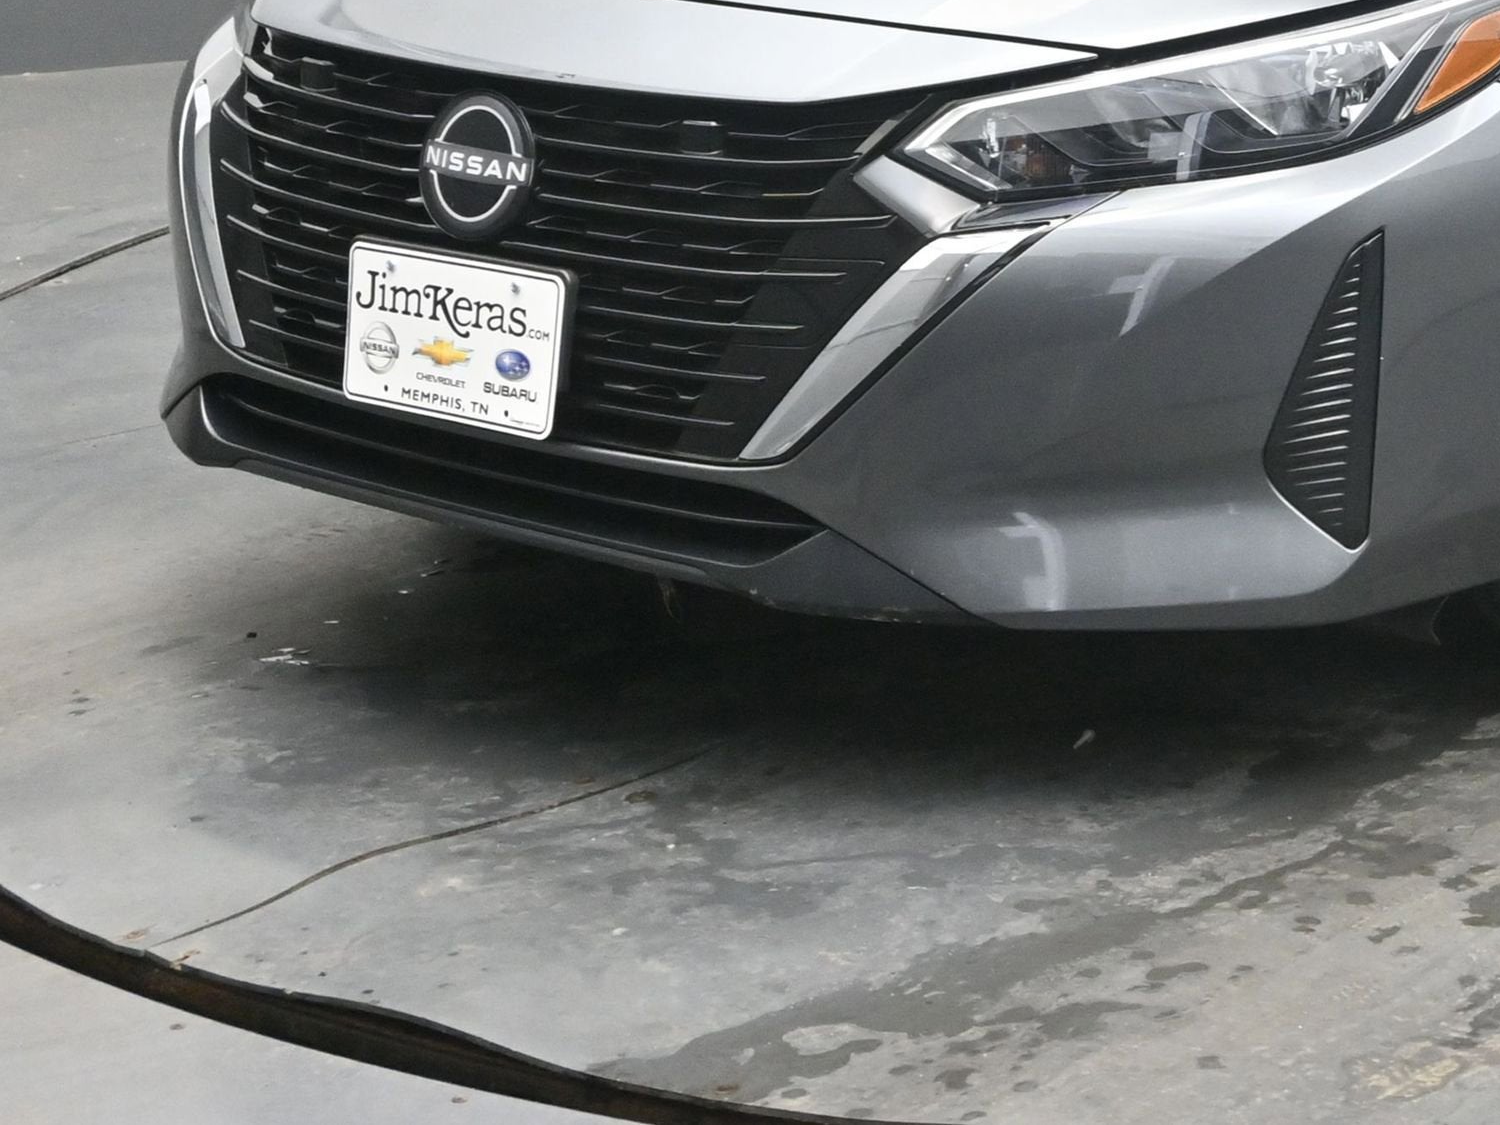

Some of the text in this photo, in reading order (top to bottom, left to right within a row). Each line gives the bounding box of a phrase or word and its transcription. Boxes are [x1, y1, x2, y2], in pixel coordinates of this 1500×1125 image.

[426, 145, 527, 182] NISSAN
[363, 341, 396, 356] NISSAN
[416, 372, 466, 389] CHEVROLET
[401, 387, 489, 416] MEMPHIS, TN
[483, 381, 537, 403] SUBARU
